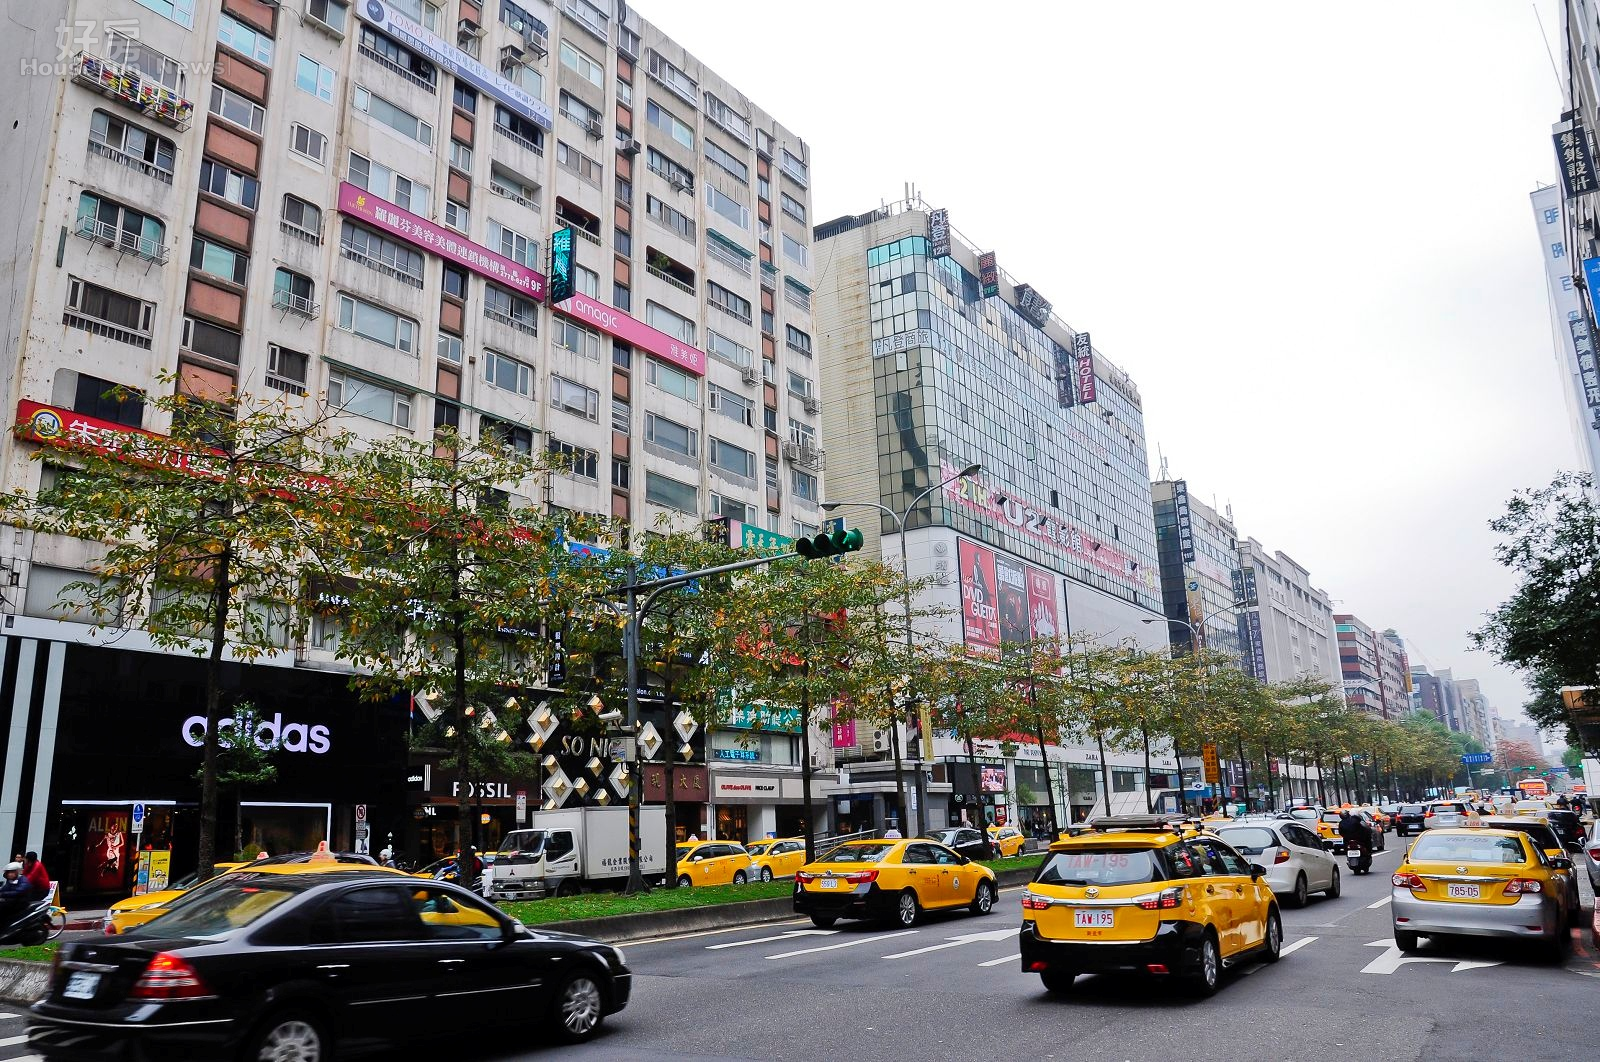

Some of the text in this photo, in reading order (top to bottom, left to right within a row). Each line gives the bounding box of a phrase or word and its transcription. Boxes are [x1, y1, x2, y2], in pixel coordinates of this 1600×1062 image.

[374, 205, 500, 275] 羅麗芬美容美體連鎖機構
[530, 278, 542, 293] 9F
[575, 300, 618, 329] amagic
[1077, 333, 1091, 359] 友統
[1080, 359, 1092, 400] HOTEL
[182, 713, 331, 754] adidas
[560, 735, 584, 756] SO
[1085, 753, 1099, 761] ZARA
[88, 818, 111, 833] ALL
[1075, 913, 1113, 924] TAW-195
